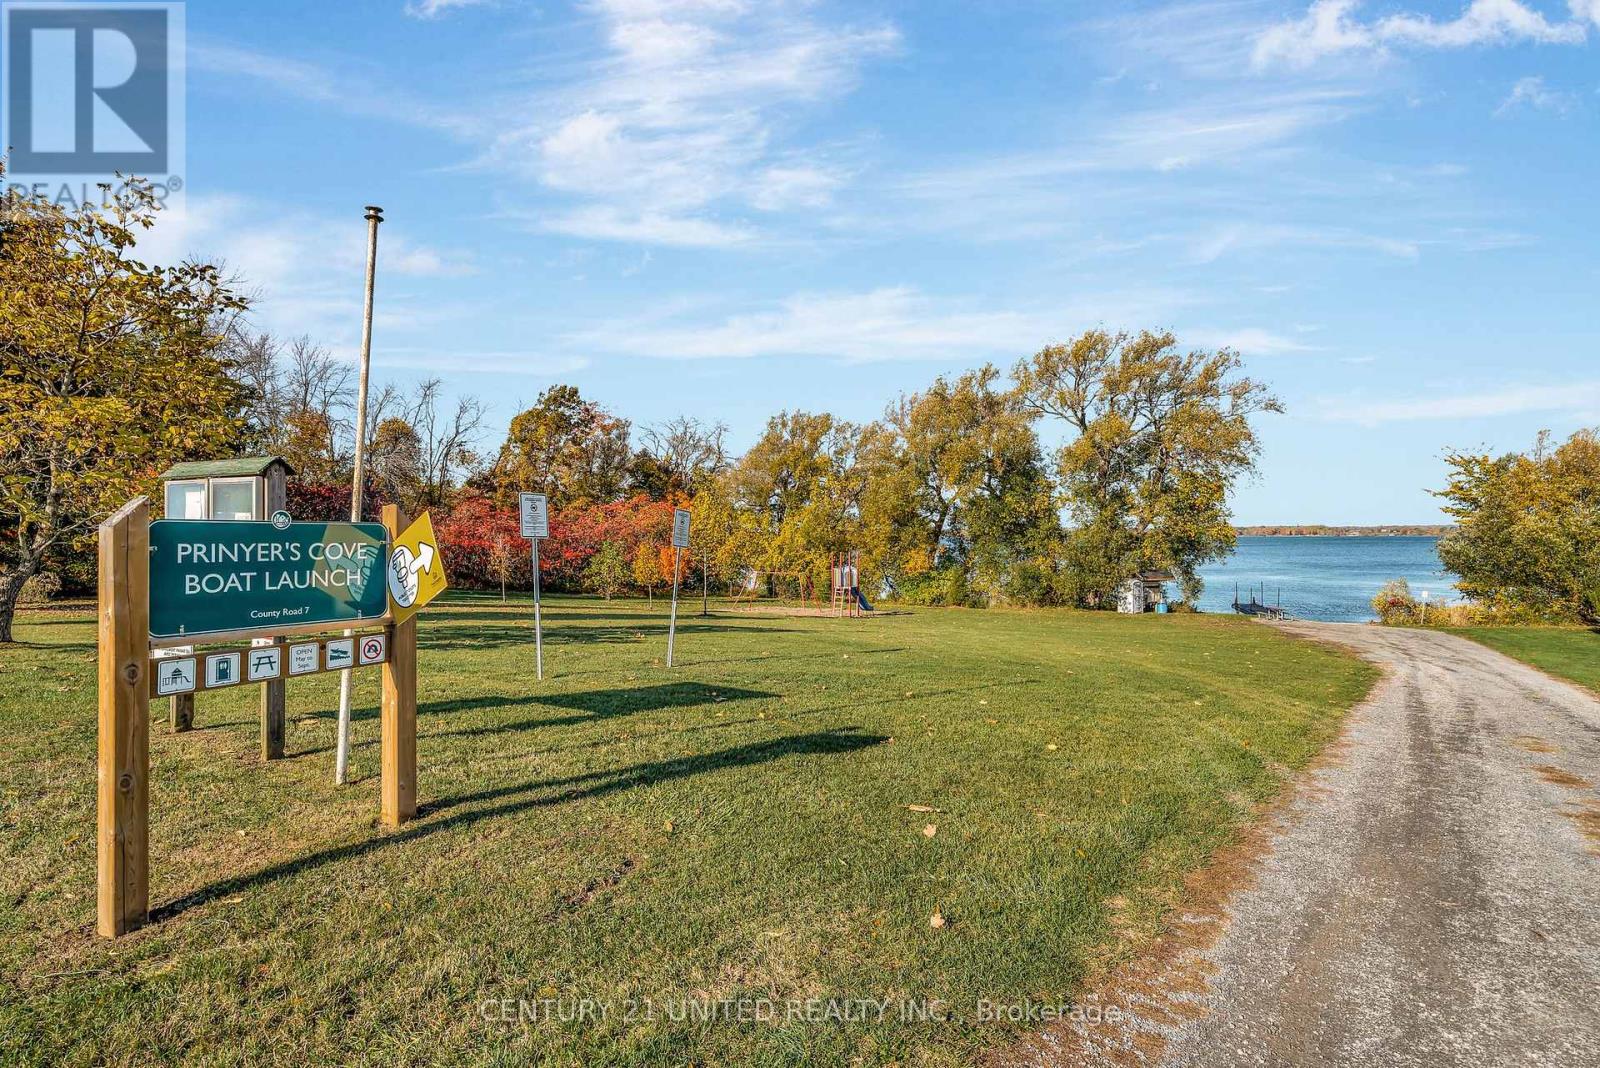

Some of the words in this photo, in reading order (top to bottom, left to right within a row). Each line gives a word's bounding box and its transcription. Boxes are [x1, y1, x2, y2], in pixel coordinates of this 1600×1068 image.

[177, 542, 301, 563] PRINYER'S
[308, 542, 367, 560] COVE
[185, 572, 257, 595] BOAT
[265, 569, 362, 591] LAUNCH
[250, 608, 281, 619] County
[283, 607, 304, 616] Road
[304, 606, 310, 615] 7
[295, 648, 313, 656] OPEN
